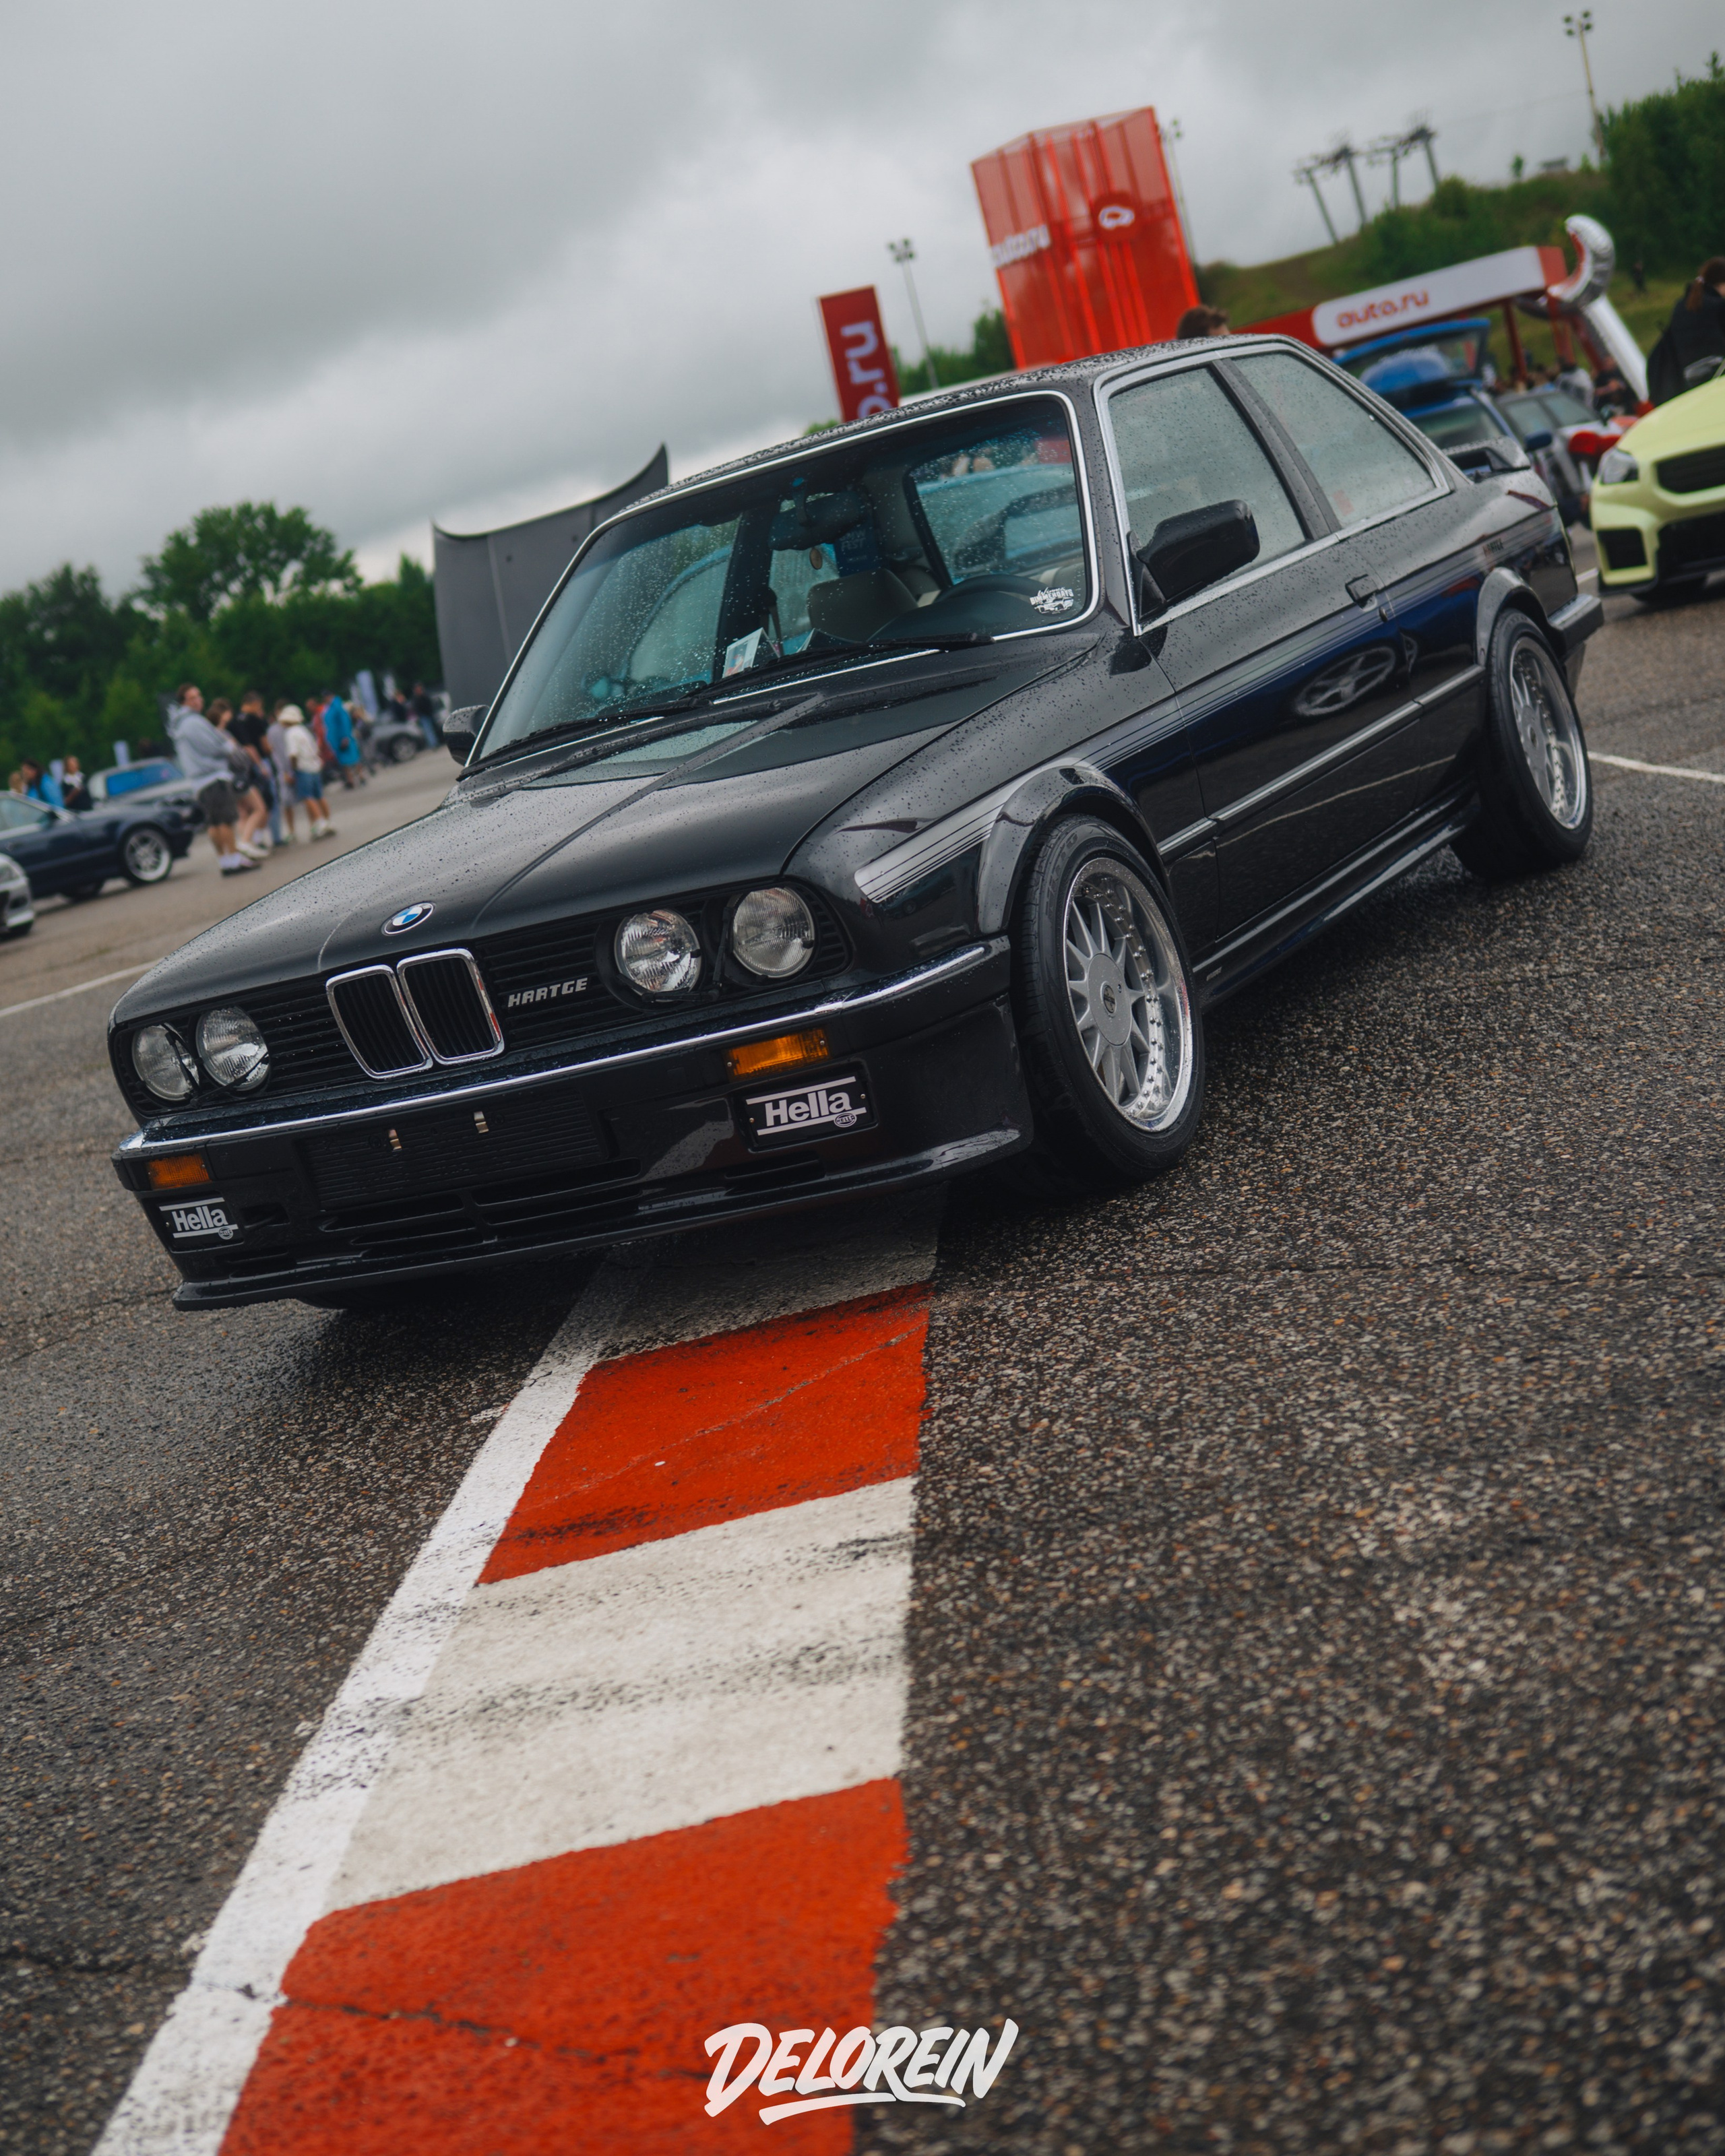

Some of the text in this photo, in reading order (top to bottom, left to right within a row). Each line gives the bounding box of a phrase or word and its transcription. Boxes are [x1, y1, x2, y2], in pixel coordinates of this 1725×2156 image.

[1338, 290, 1429, 328] auto.ru
[507, 978, 588, 1008] HARTGE
[765, 1089, 852, 1127] Hella
[836, 1115, 856, 1124] HELLA
[172, 1205, 228, 1232] Hella
